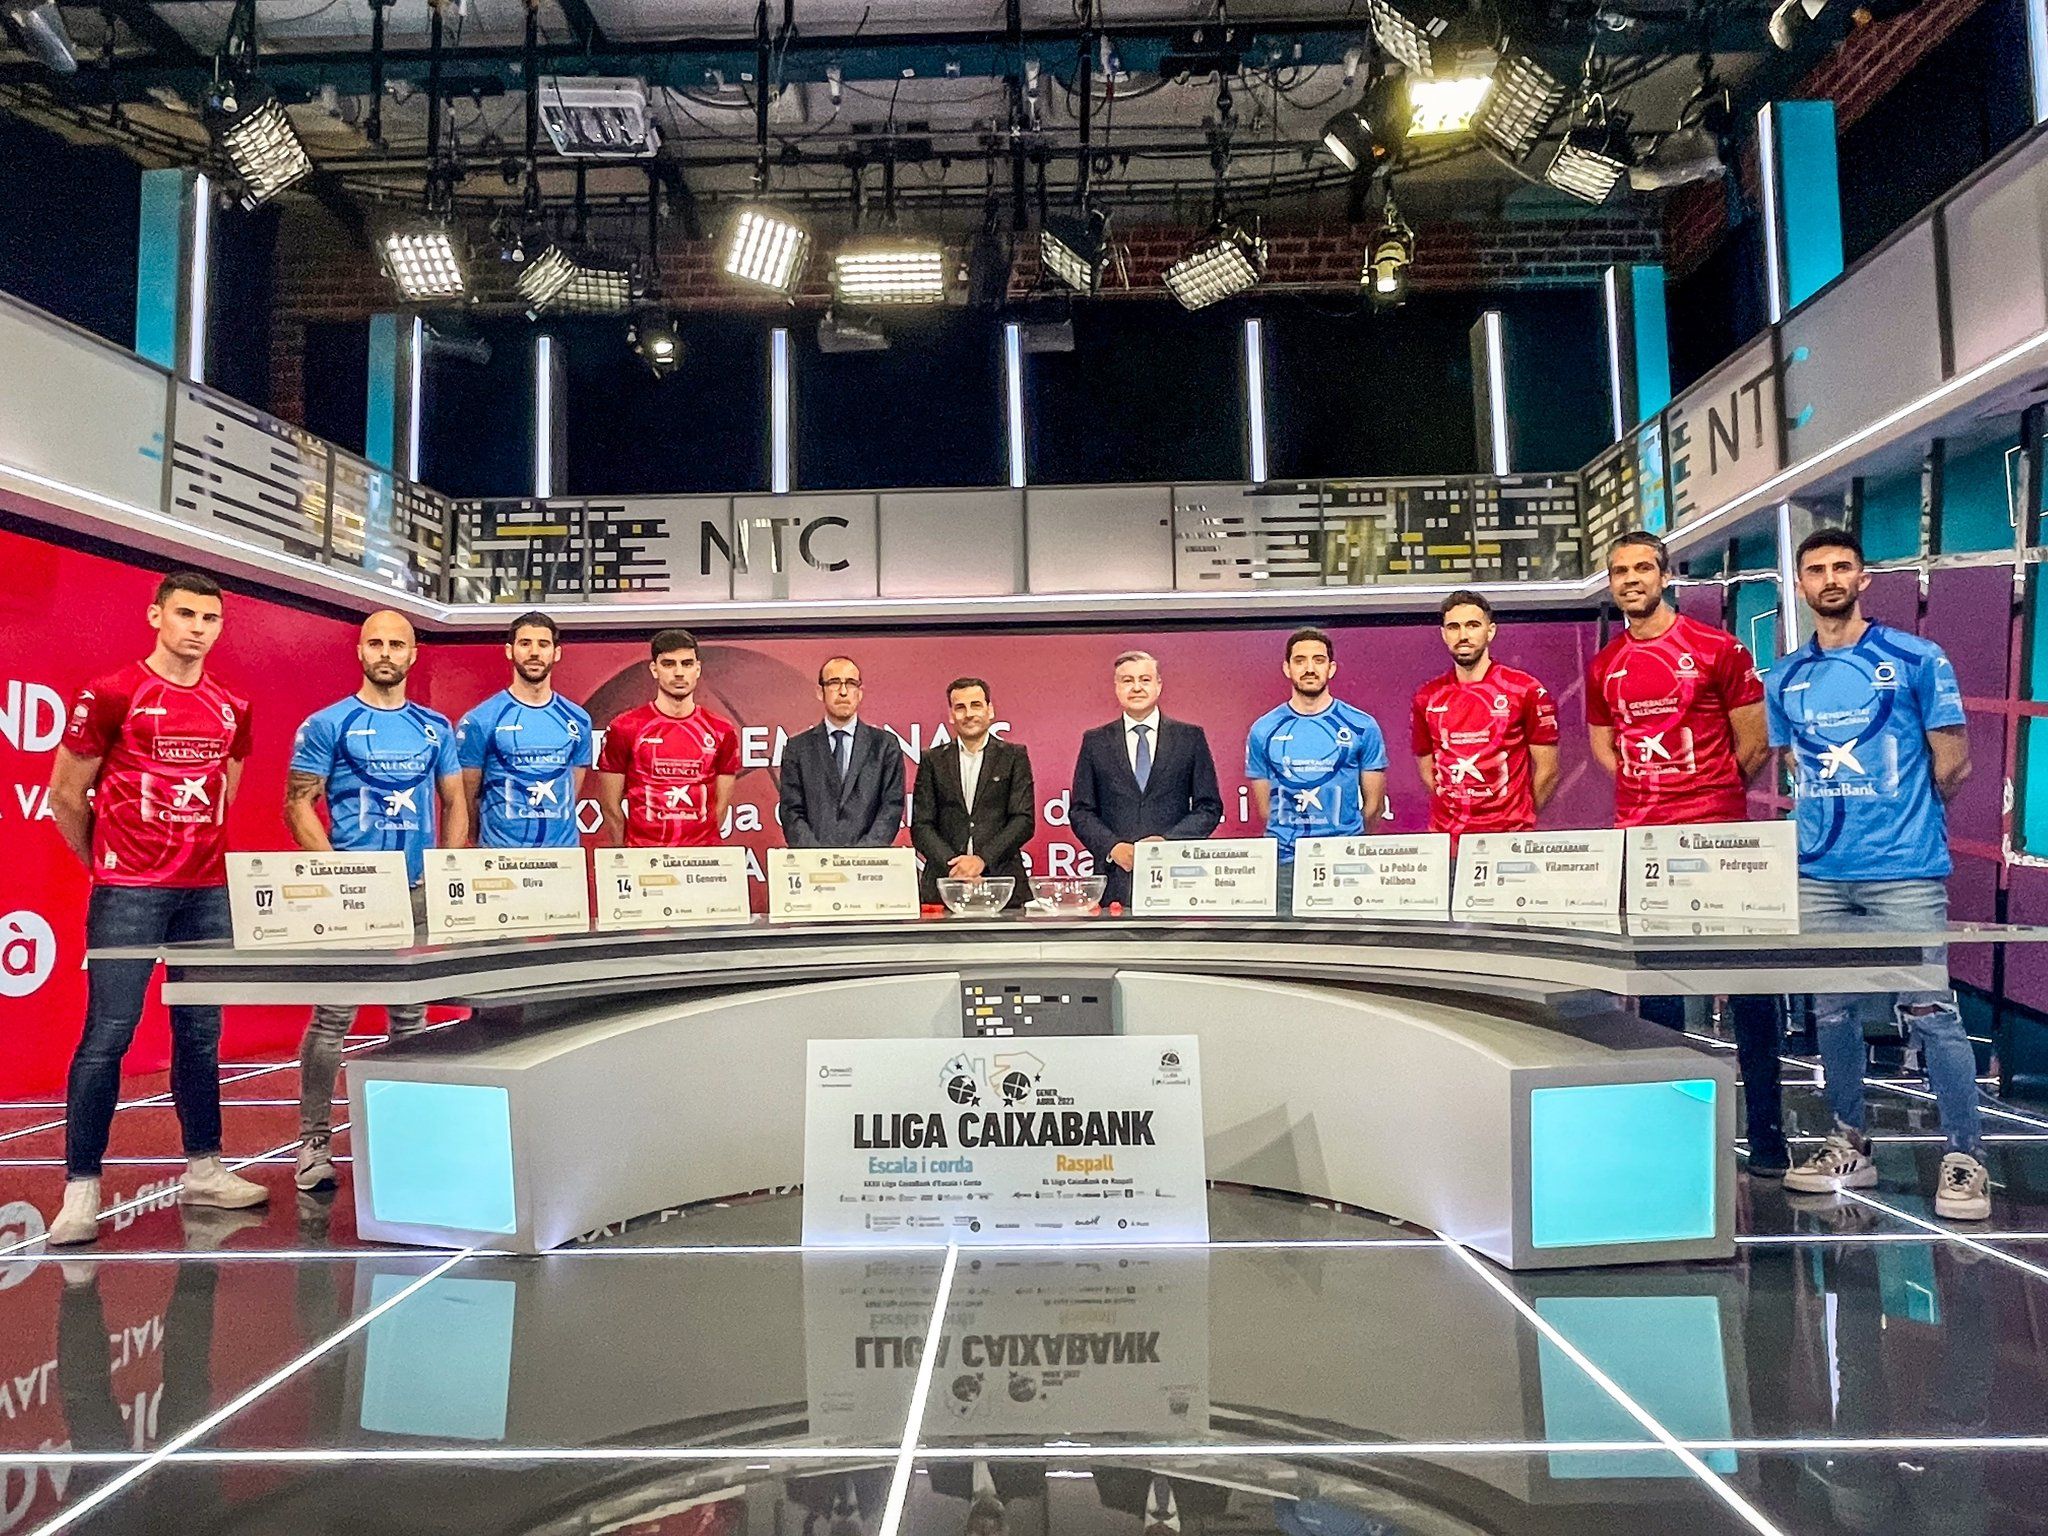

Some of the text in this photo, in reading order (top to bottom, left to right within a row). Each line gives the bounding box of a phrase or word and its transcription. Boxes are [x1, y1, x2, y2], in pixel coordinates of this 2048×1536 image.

[701, 516, 849, 575] NTC
[1215, 865, 1222, 875] El
[1380, 862, 1427, 873] La Pobla de
[1474, 865, 1488, 880] 21
[1545, 861, 1600, 872] Vilamarxant
[1645, 863, 1660, 880] 22
[1720, 859, 1768, 873] Pedreguer
[686, 874, 694, 884] El
[1150, 870, 1163, 884] 14
[1313, 867, 1326, 881] 15
[339, 884, 367, 895] Ciscar
[522, 877, 543, 889] Oliva
[617, 879, 632, 893] 14
[788, 876, 802, 889] 16
[448, 883, 465, 898] 08
[256, 890, 274, 907] 07
[343, 900, 366, 910] Piles
[854, 1110, 1156, 1149] LLIGA CAIXABANK
[868, 1155, 974, 1174] Escala i corda
[1056, 1154, 1115, 1175] Raspall
